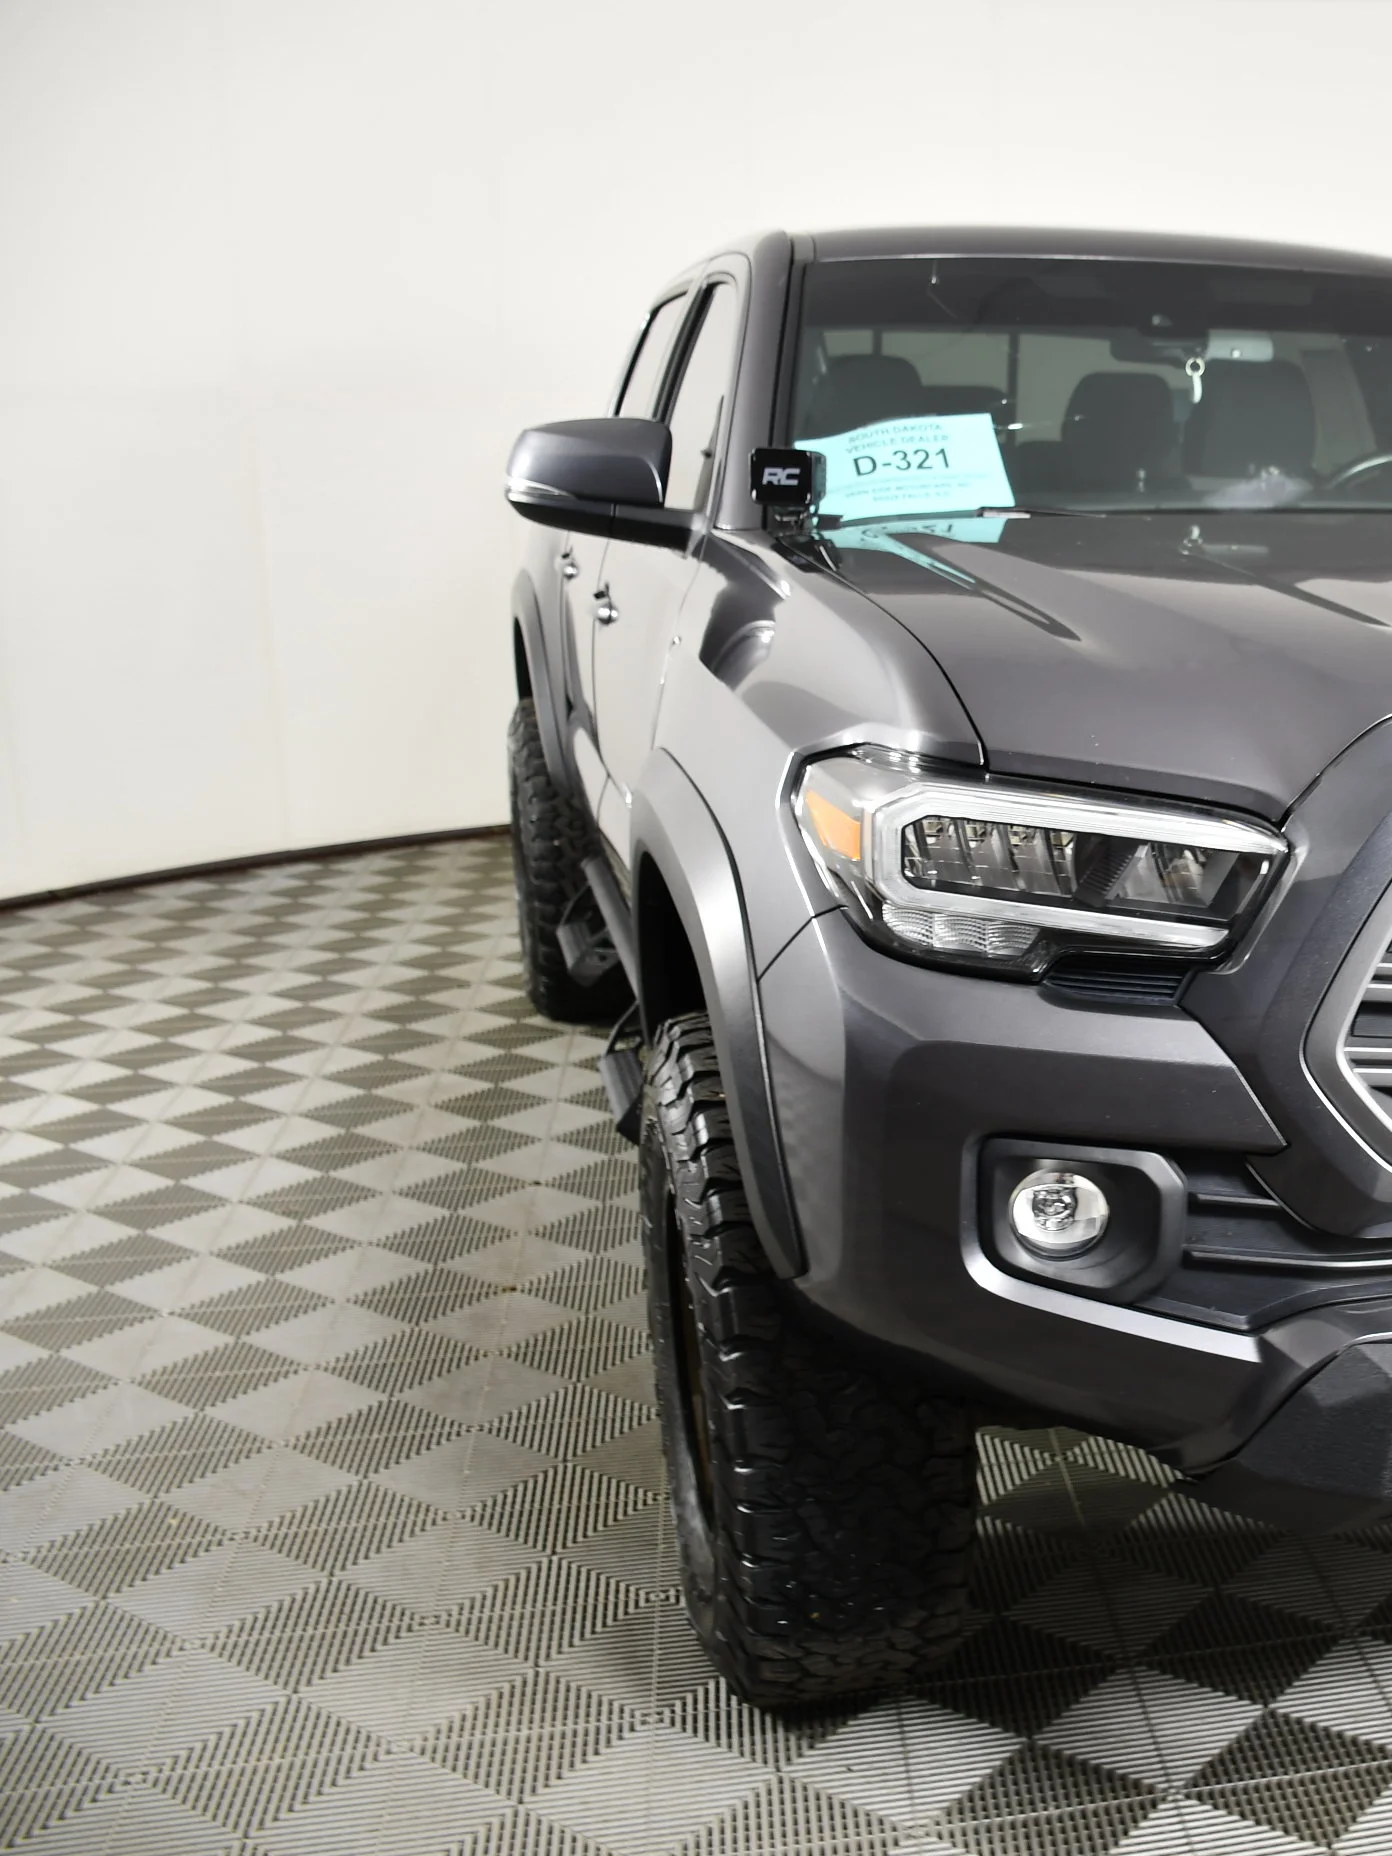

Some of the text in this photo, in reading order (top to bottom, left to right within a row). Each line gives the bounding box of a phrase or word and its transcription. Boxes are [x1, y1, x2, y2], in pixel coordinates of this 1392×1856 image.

[893, 422, 943, 435] DAKOTA
[845, 434, 950, 454] VEHICLE DEALER
[853, 448, 950, 477] D-321
[762, 467, 800, 486] RC
